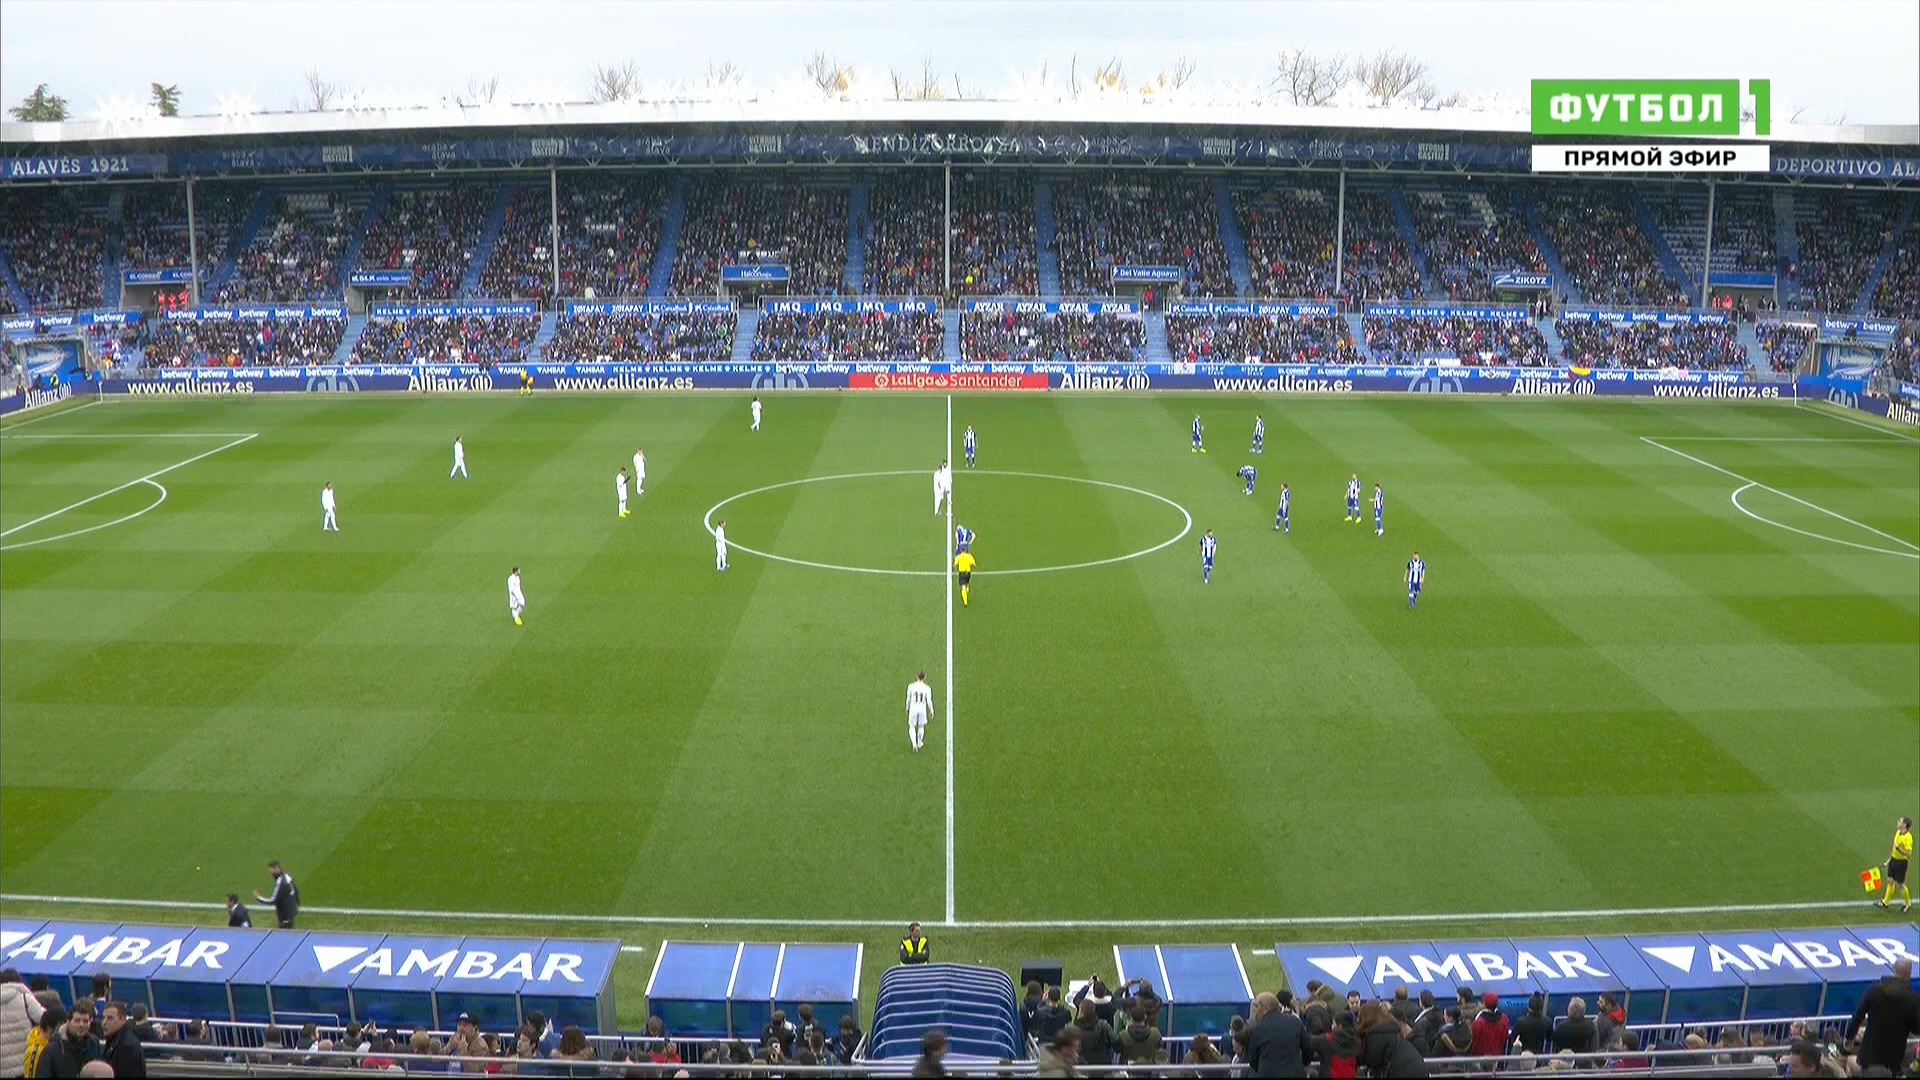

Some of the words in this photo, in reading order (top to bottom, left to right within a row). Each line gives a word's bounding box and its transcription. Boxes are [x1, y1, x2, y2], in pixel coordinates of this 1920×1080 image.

[12, 155, 81, 176] ALAVÉS
[91, 157, 129, 172] 1921
[1776, 157, 1881, 176] DEPORTIVO
[1120, 269, 1132, 277] Del
[1515, 276, 1547, 284] ZIKOTZ
[168, 309, 197, 319] betway
[204, 309, 233, 319] betway
[239, 308, 269, 318] betway
[275, 308, 304, 318] betway
[311, 307, 341, 317] betway
[774, 302, 801, 312] IMQ
[815, 302, 842, 312] IMQ
[857, 302, 884, 312] IMQ
[899, 302, 926, 312] IMQ
[974, 303, 1004, 312] AYZAR
[1016, 303, 1047, 312] AYZAR
[1058, 304, 1089, 312] AYZAR
[1101, 304, 1131, 313] AYZAR
[94, 313, 126, 323] betway
[1565, 311, 1591, 321] betway
[1599, 312, 1625, 322] betway
[1632, 313, 1658, 323] betway
[1665, 314, 1691, 323] betway
[1699, 314, 1724, 324] betway
[1863, 321, 1897, 334] betway
[161, 369, 192, 379] betway
[197, 369, 228, 379] betway
[233, 368, 264, 379] betway
[269, 368, 300, 379] betway
[305, 368, 337, 378] betway
[342, 367, 374, 377] betway
[381, 367, 413, 377] betway
[732, 365, 763, 373] KELME
[815, 364, 850, 374] betway
[855, 364, 891, 374] betway
[896, 364, 931, 374] betway
[950, 364, 985, 374] betway
[991, 364, 1026, 374] betway
[1032, 364, 1068, 374] betway
[1074, 364, 1109, 375] betway
[1438, 368, 1470, 378] betway
[1520, 369, 1551, 380] betway
[407, 376, 468, 392] Allianz
[554, 374, 694, 390] www.allianz.es
[892, 374, 935, 389] LaLiga
[950, 374, 1022, 387] Santander
[1060, 373, 1123, 389] Allianz
[1214, 374, 1353, 391] www.allianz.es
[1596, 371, 1629, 381] betway
[1708, 373, 1738, 383] betway
[127, 378, 254, 394] www.allianz.es
[1511, 378, 1571, 394] Allianz
[1653, 382, 1779, 398] www.allianz.es
[25, 386, 60, 408] Allianz
[914, 691, 923, 703] 11
[8, 933, 229, 969] AMBAR
[1709, 938, 1919, 973] AMBAR
[349, 948, 584, 982] AMBAR
[1373, 950, 1611, 985] AMBAR
